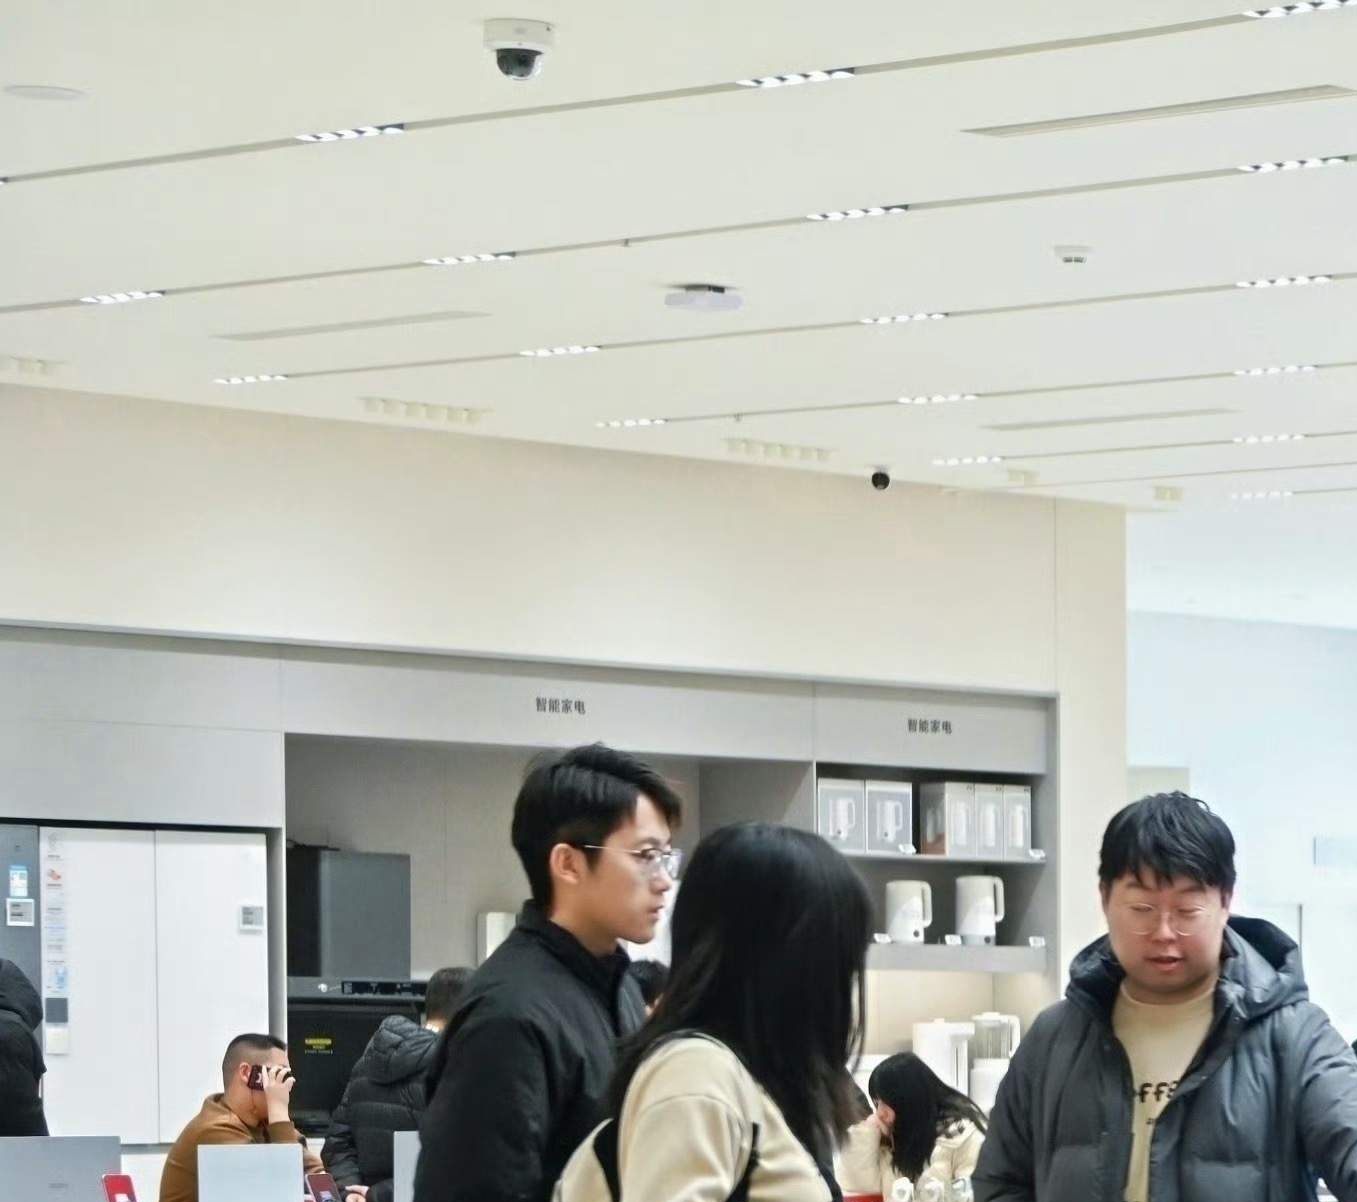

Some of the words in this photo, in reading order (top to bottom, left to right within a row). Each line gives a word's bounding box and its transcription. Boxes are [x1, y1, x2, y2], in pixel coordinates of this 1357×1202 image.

[536, 697, 586, 714] 智能家电
[907, 718, 952, 734] 智能家电
